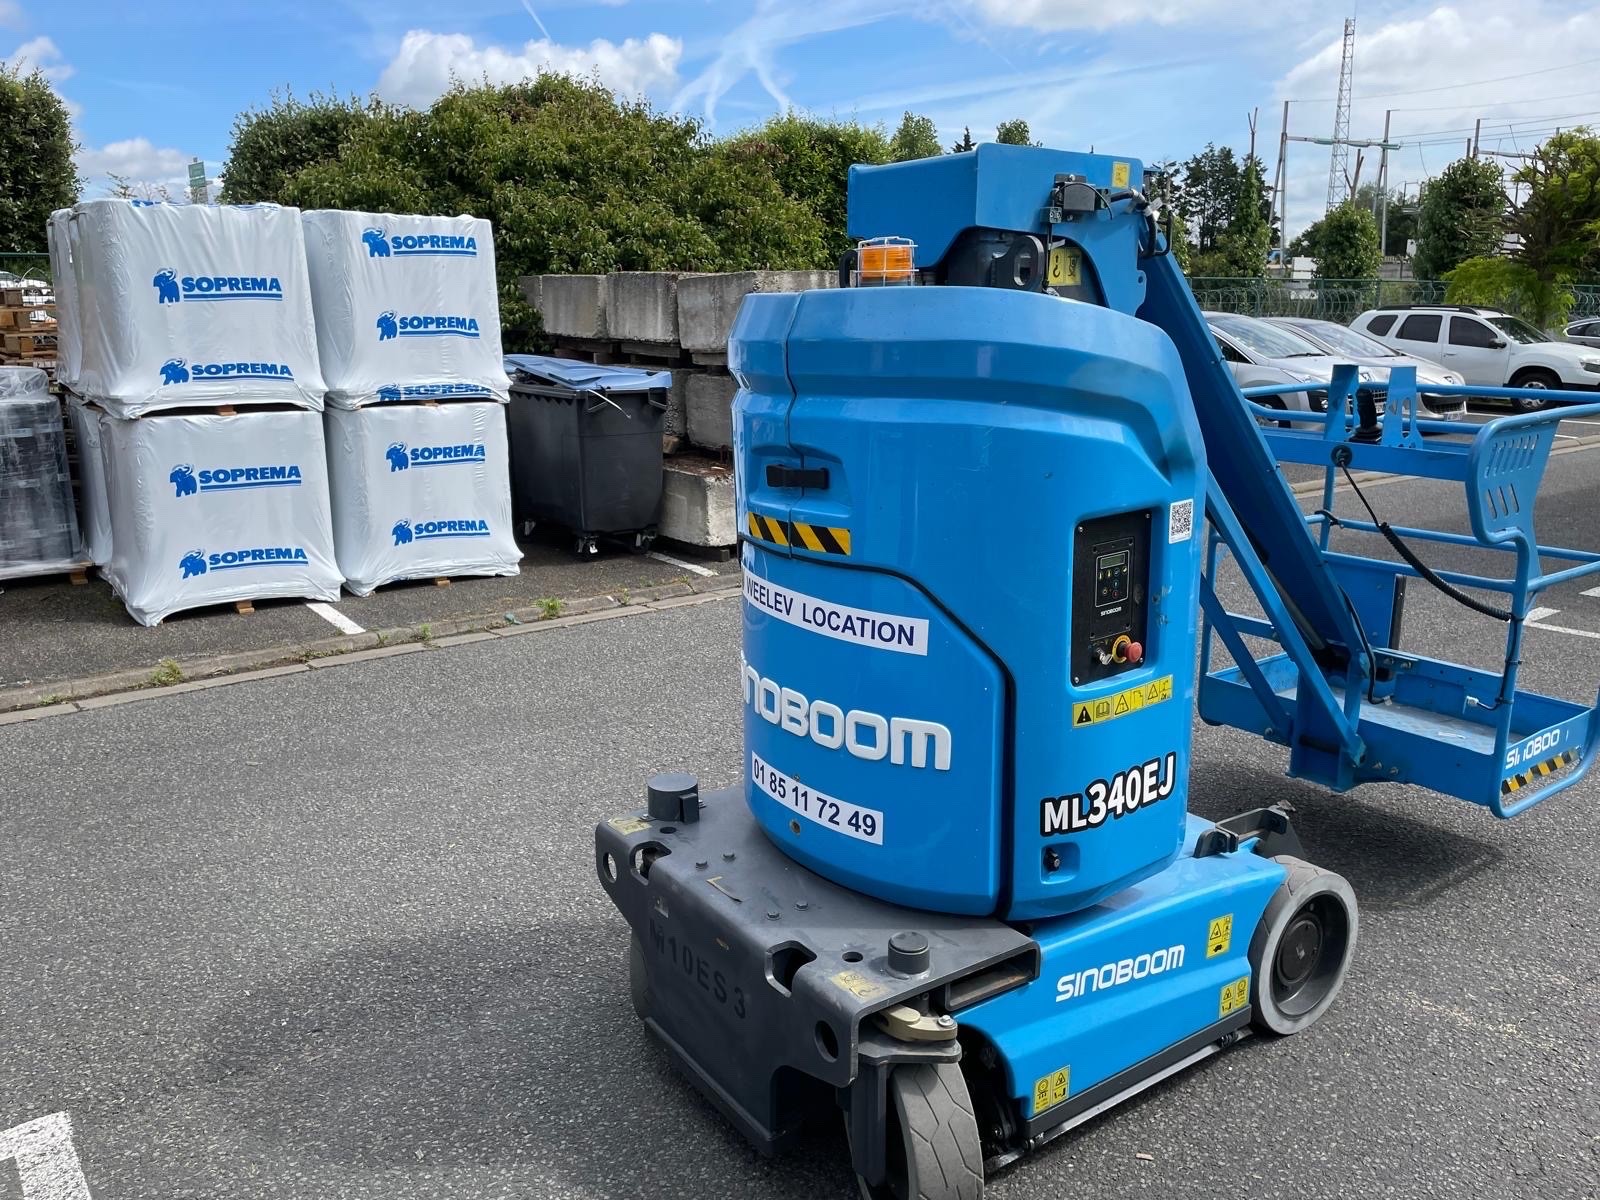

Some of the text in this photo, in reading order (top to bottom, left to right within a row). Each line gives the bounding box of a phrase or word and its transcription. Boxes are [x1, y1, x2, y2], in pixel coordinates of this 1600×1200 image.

[391, 235, 477, 250] SOPREMA
[181, 276, 282, 292] SOPREMA
[399, 316, 479, 331] SOPREMA
[191, 363, 293, 376] SOPREMA
[410, 444, 486, 461] SOPREMA
[198, 466, 301, 484] SOPREMA
[414, 519, 489, 535] SOPREMA
[208, 548, 307, 566] SOPREMA
[746, 575, 915, 646] WEELEV LOCATION
[741, 649, 951, 771] NOBOOM
[754, 758, 876, 837] 01 85 11 72 49
[1042, 753, 1175, 835] ML340EJ
[1055, 944, 1185, 1003] SINOBOOM
